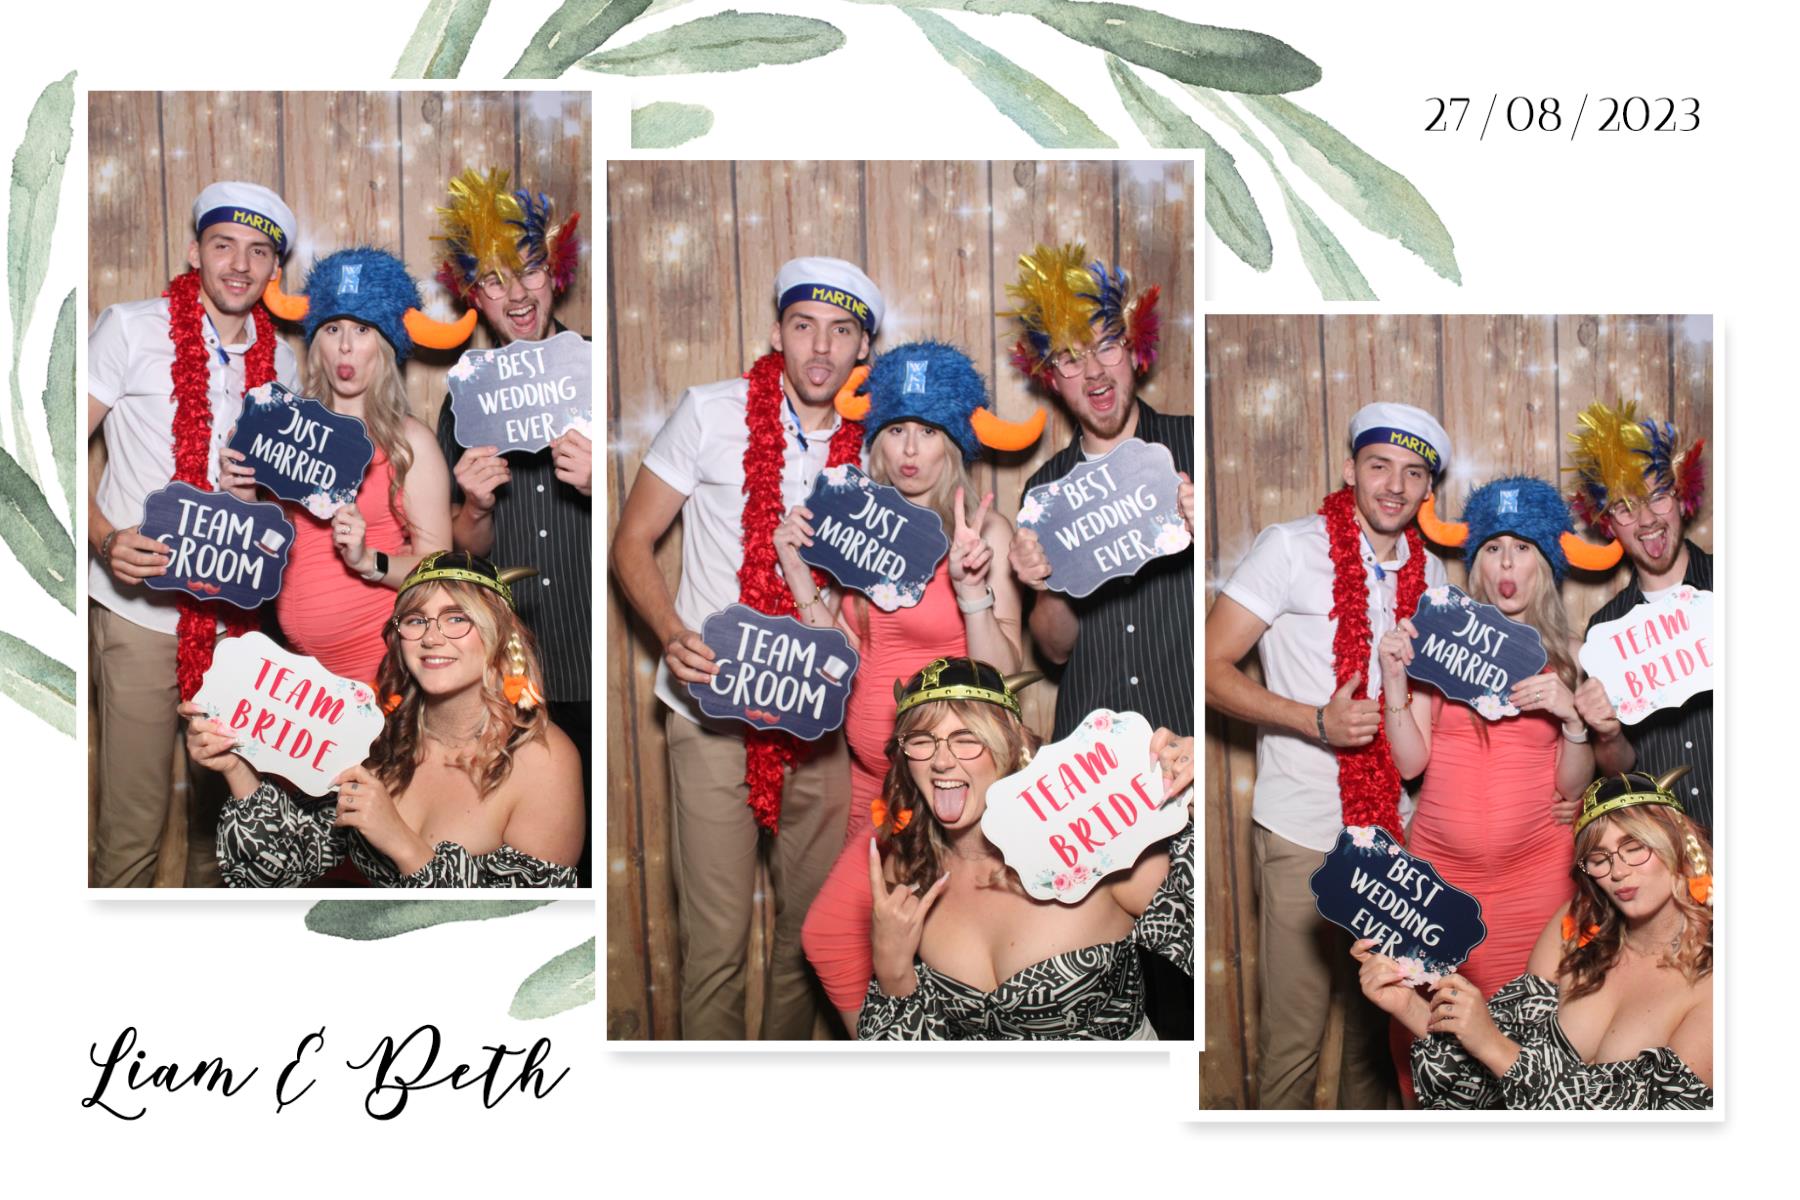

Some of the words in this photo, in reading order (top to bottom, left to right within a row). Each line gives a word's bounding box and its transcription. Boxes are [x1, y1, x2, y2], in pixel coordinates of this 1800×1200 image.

[233, 210, 283, 244] MARINE
[812, 287, 868, 320] MARINE
[497, 347, 545, 380] BEST
[477, 376, 577, 415] WEDDING
[278, 406, 334, 454] JUST
[505, 413, 558, 443] EVER
[1390, 431, 1437, 465] MARINE
[249, 433, 337, 490] MARRIED
[1062, 463, 1117, 511] BEST
[178, 499, 254, 550] TEAM
[848, 491, 909, 543] JUST
[1054, 484, 1157, 551] WEDDING
[815, 515, 907, 581] MARRIED
[1093, 529, 1154, 572] EVER
[737, 622, 816, 678] TEAM
[1452, 609, 1509, 658] JUST
[1609, 608, 1690, 660] TEAM
[710, 658, 826, 720] GROOM
[1421, 633, 1508, 693] MARRIED
[1624, 637, 1713, 698] BRIDE
[254, 657, 345, 725] TEAM
[230, 698, 338, 772] BRIDE
[1016, 742, 1118, 822] TEAM
[1049, 773, 1162, 868] BRIDE
[1350, 866, 1445, 947] WEDDING
[1387, 857, 1444, 908] BEST
[1350, 908, 1403, 958] EVER
